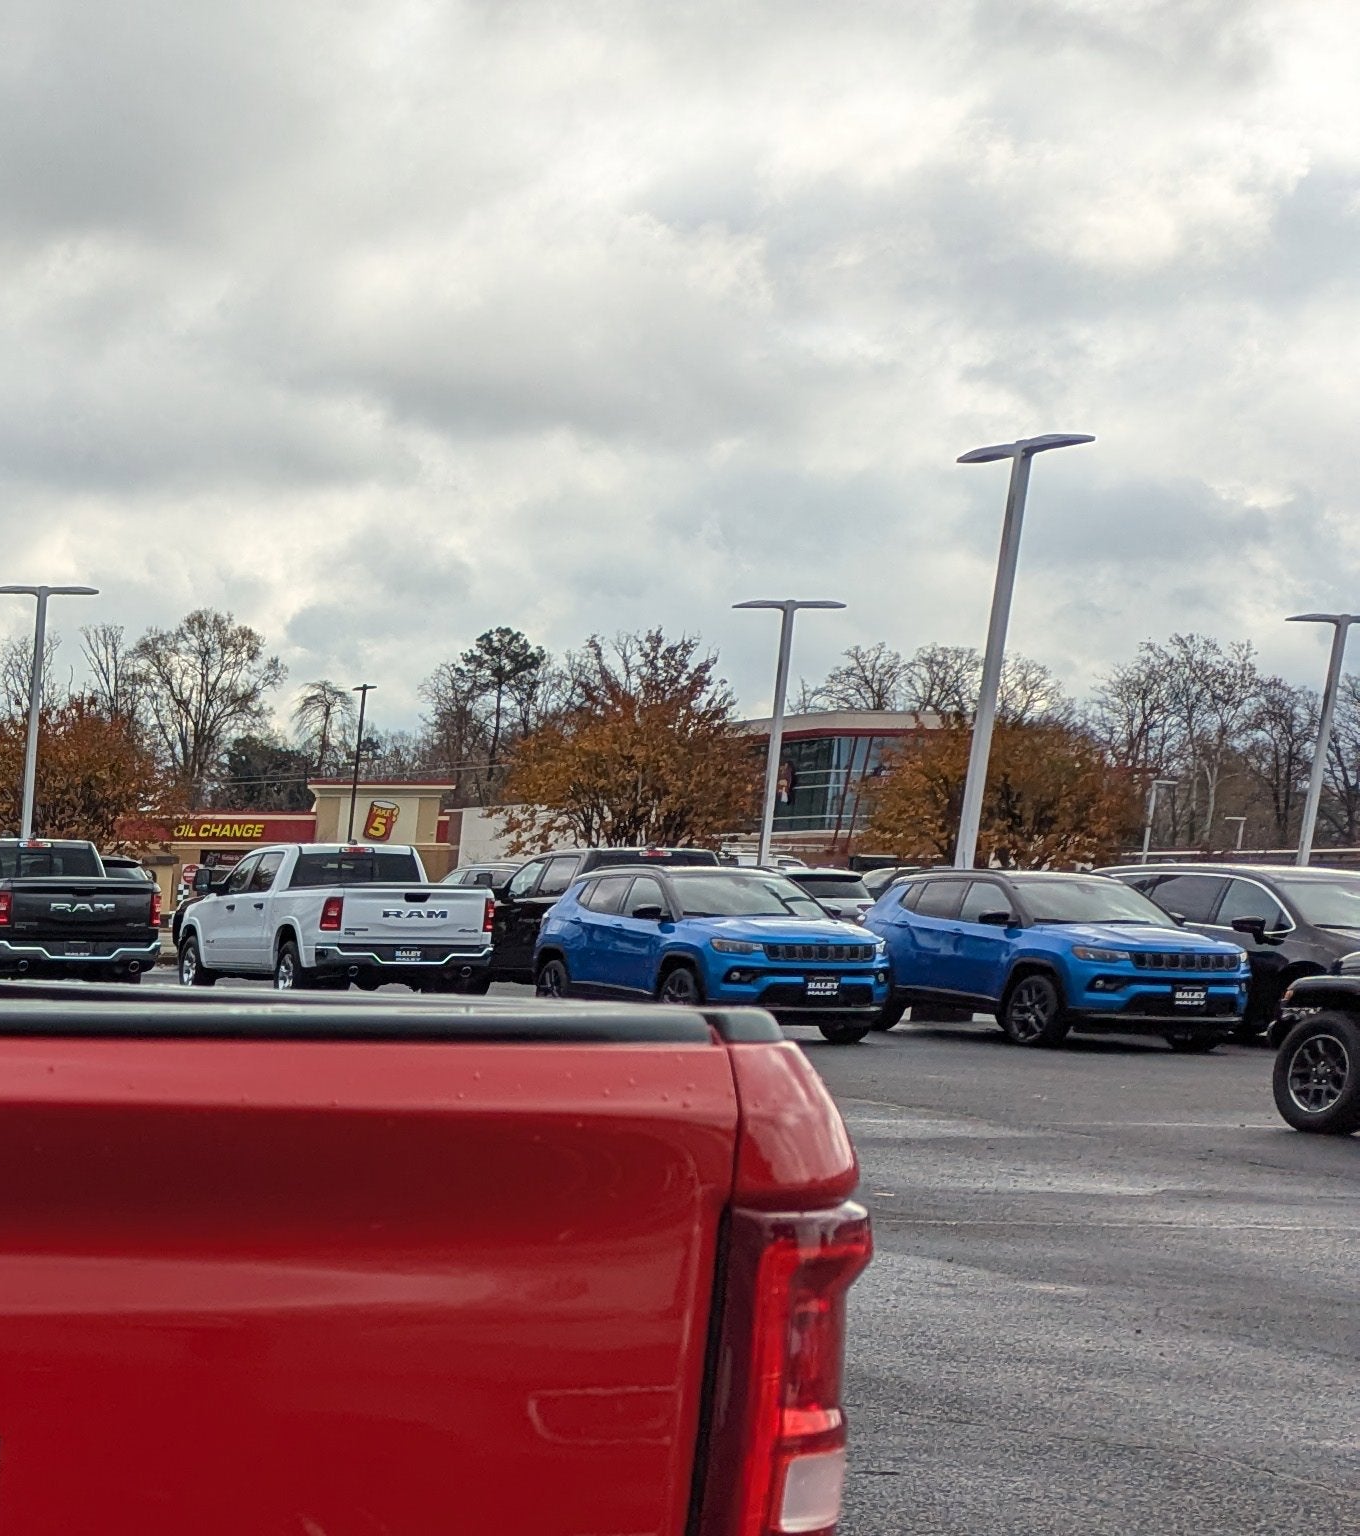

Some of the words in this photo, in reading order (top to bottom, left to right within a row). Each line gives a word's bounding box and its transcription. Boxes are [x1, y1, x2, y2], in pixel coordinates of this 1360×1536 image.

[174, 824, 196, 837] OIL
[199, 824, 265, 838] CHANGE
[368, 817, 387, 837] 5
[50, 903, 116, 913] RAM
[382, 910, 448, 919] RAM
[1175, 991, 1206, 999] HALEY
